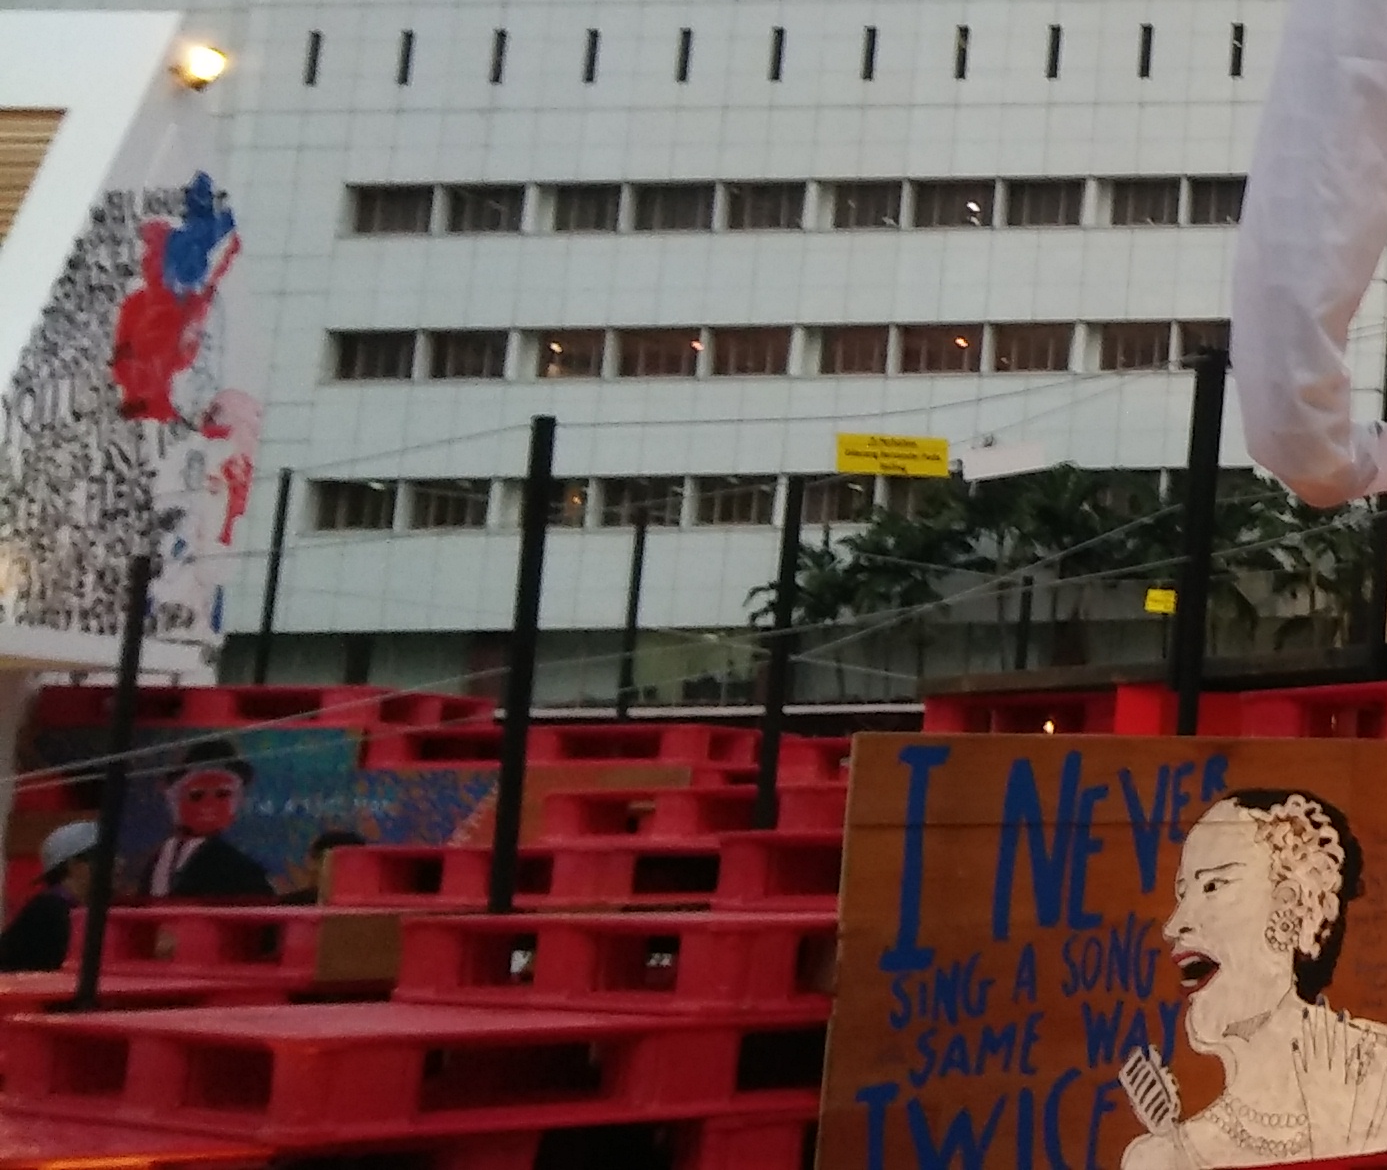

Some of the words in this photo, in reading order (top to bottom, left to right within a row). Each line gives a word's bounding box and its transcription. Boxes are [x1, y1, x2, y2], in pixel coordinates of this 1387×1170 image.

[880, 744, 951, 972] I
[992, 749, 1229, 942] NEVER
[889, 952, 996, 1030] SING
[1012, 943, 1038, 1003] A
[1062, 912, 1161, 1001] SONG
[907, 1011, 1045, 1088] SAME
[1081, 999, 1182, 1068] WAY
[855, 1068, 1122, 1170] TWICE
